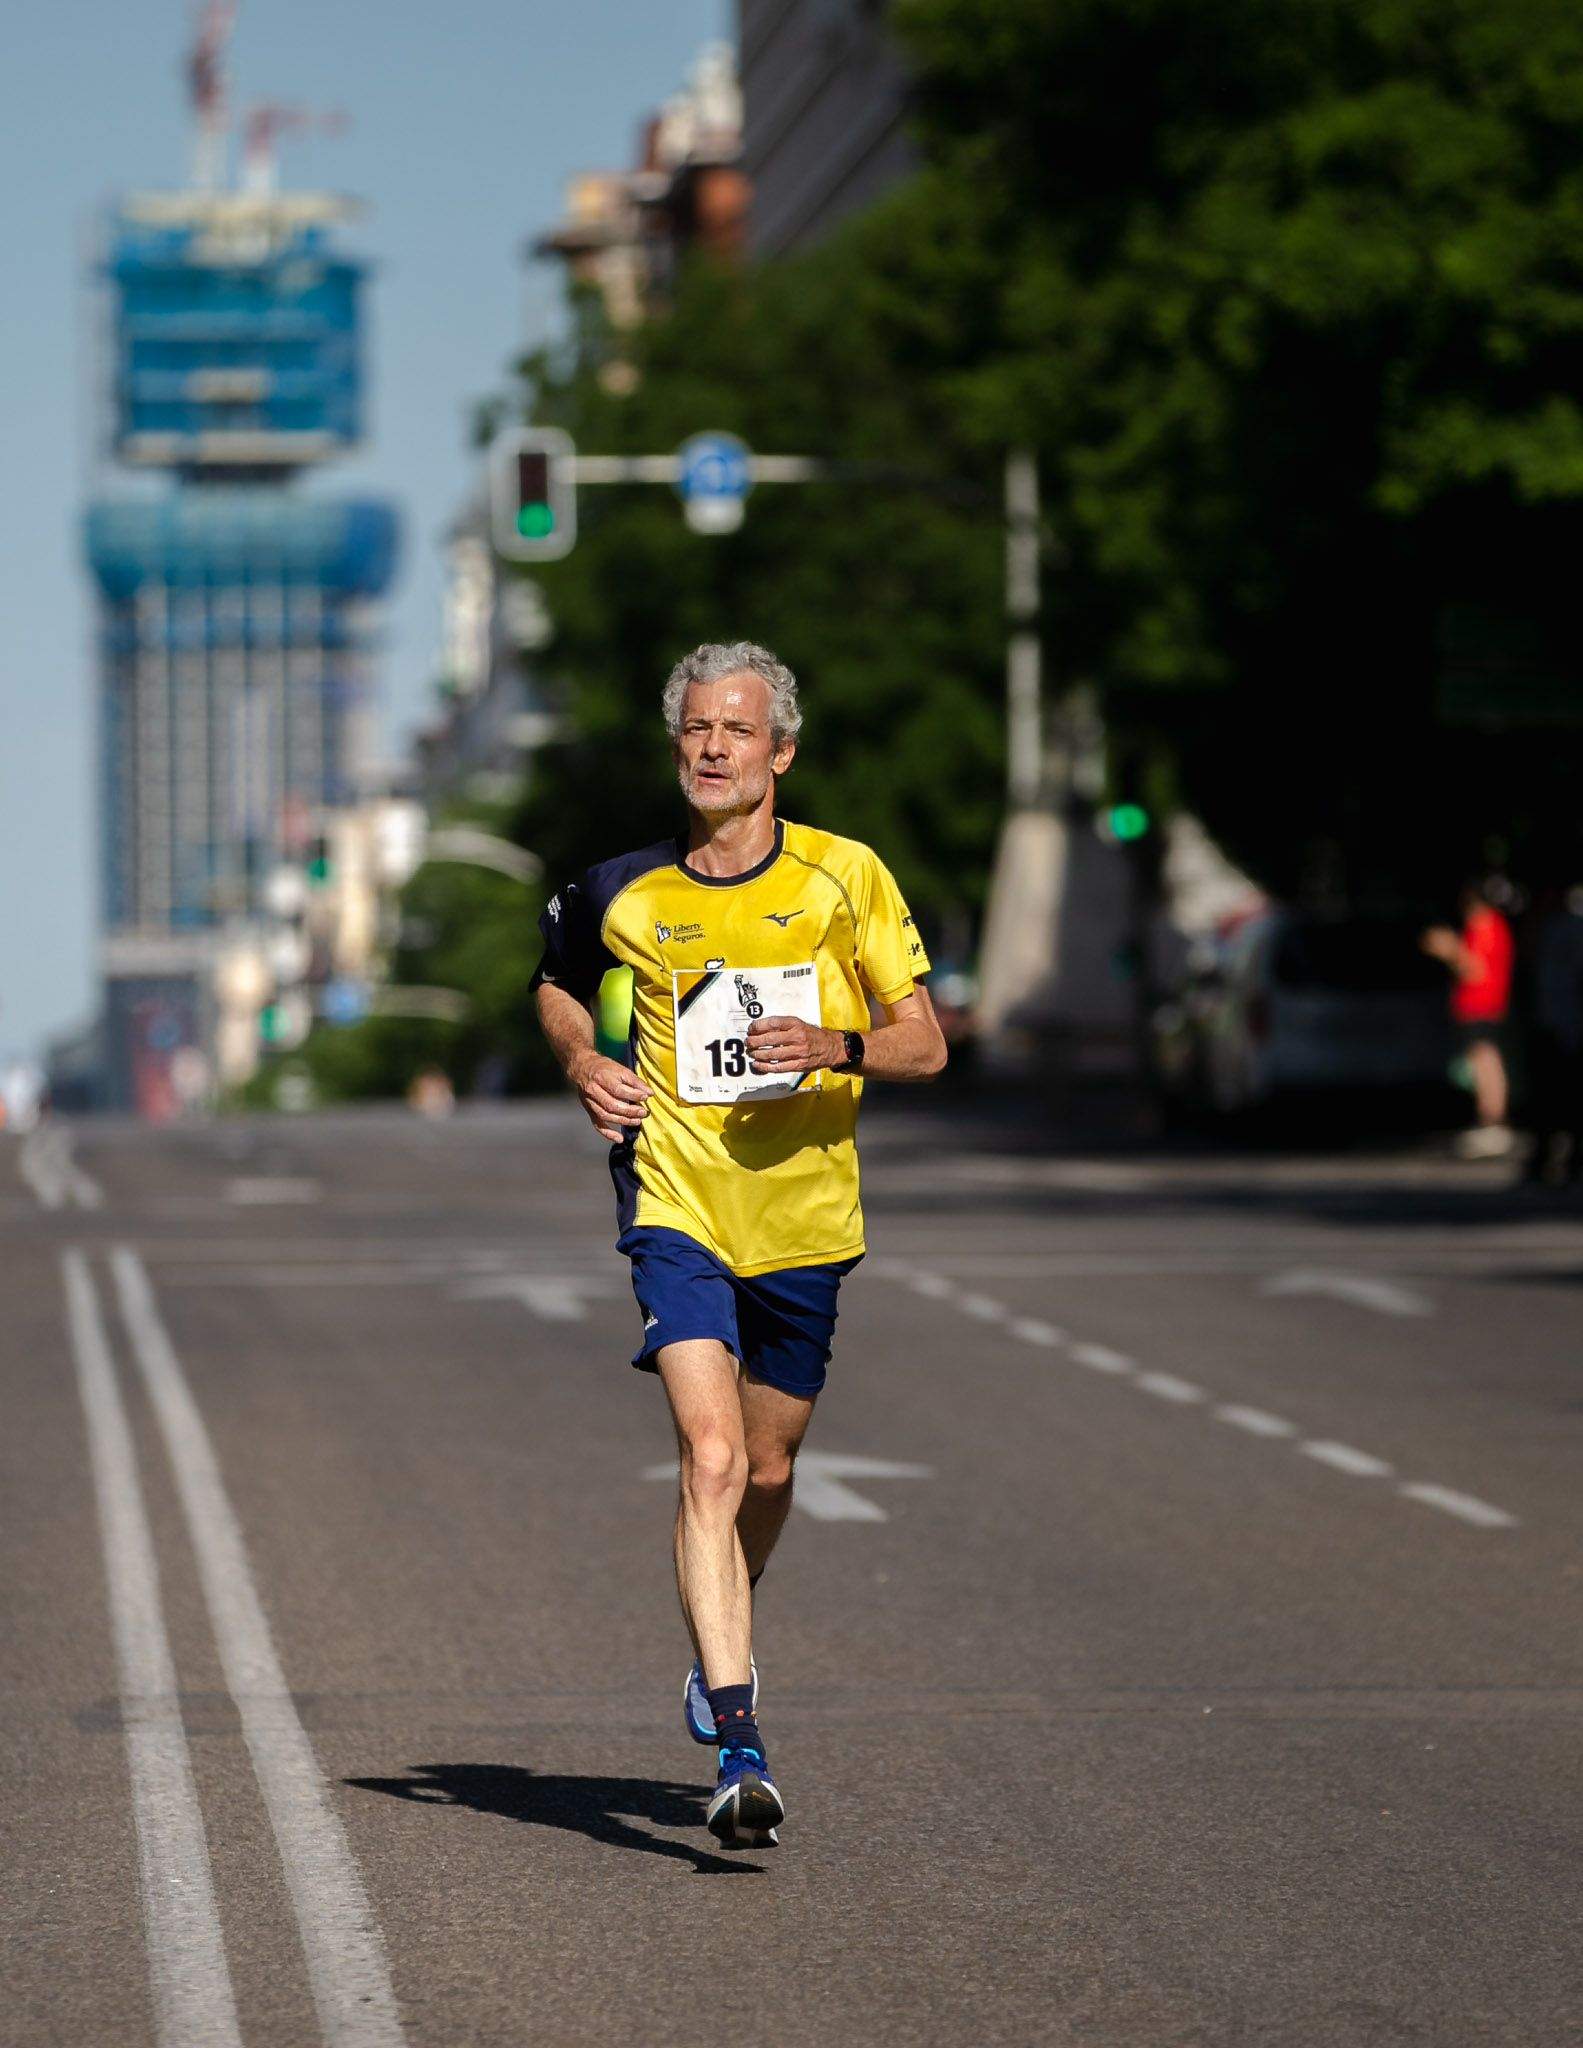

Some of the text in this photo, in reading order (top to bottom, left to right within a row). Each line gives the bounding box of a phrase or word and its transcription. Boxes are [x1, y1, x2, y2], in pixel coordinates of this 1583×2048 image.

[673, 923, 702, 933] Liberty
[749, 1005, 761, 1015] 13
[704, 1038, 768, 1078] 13
